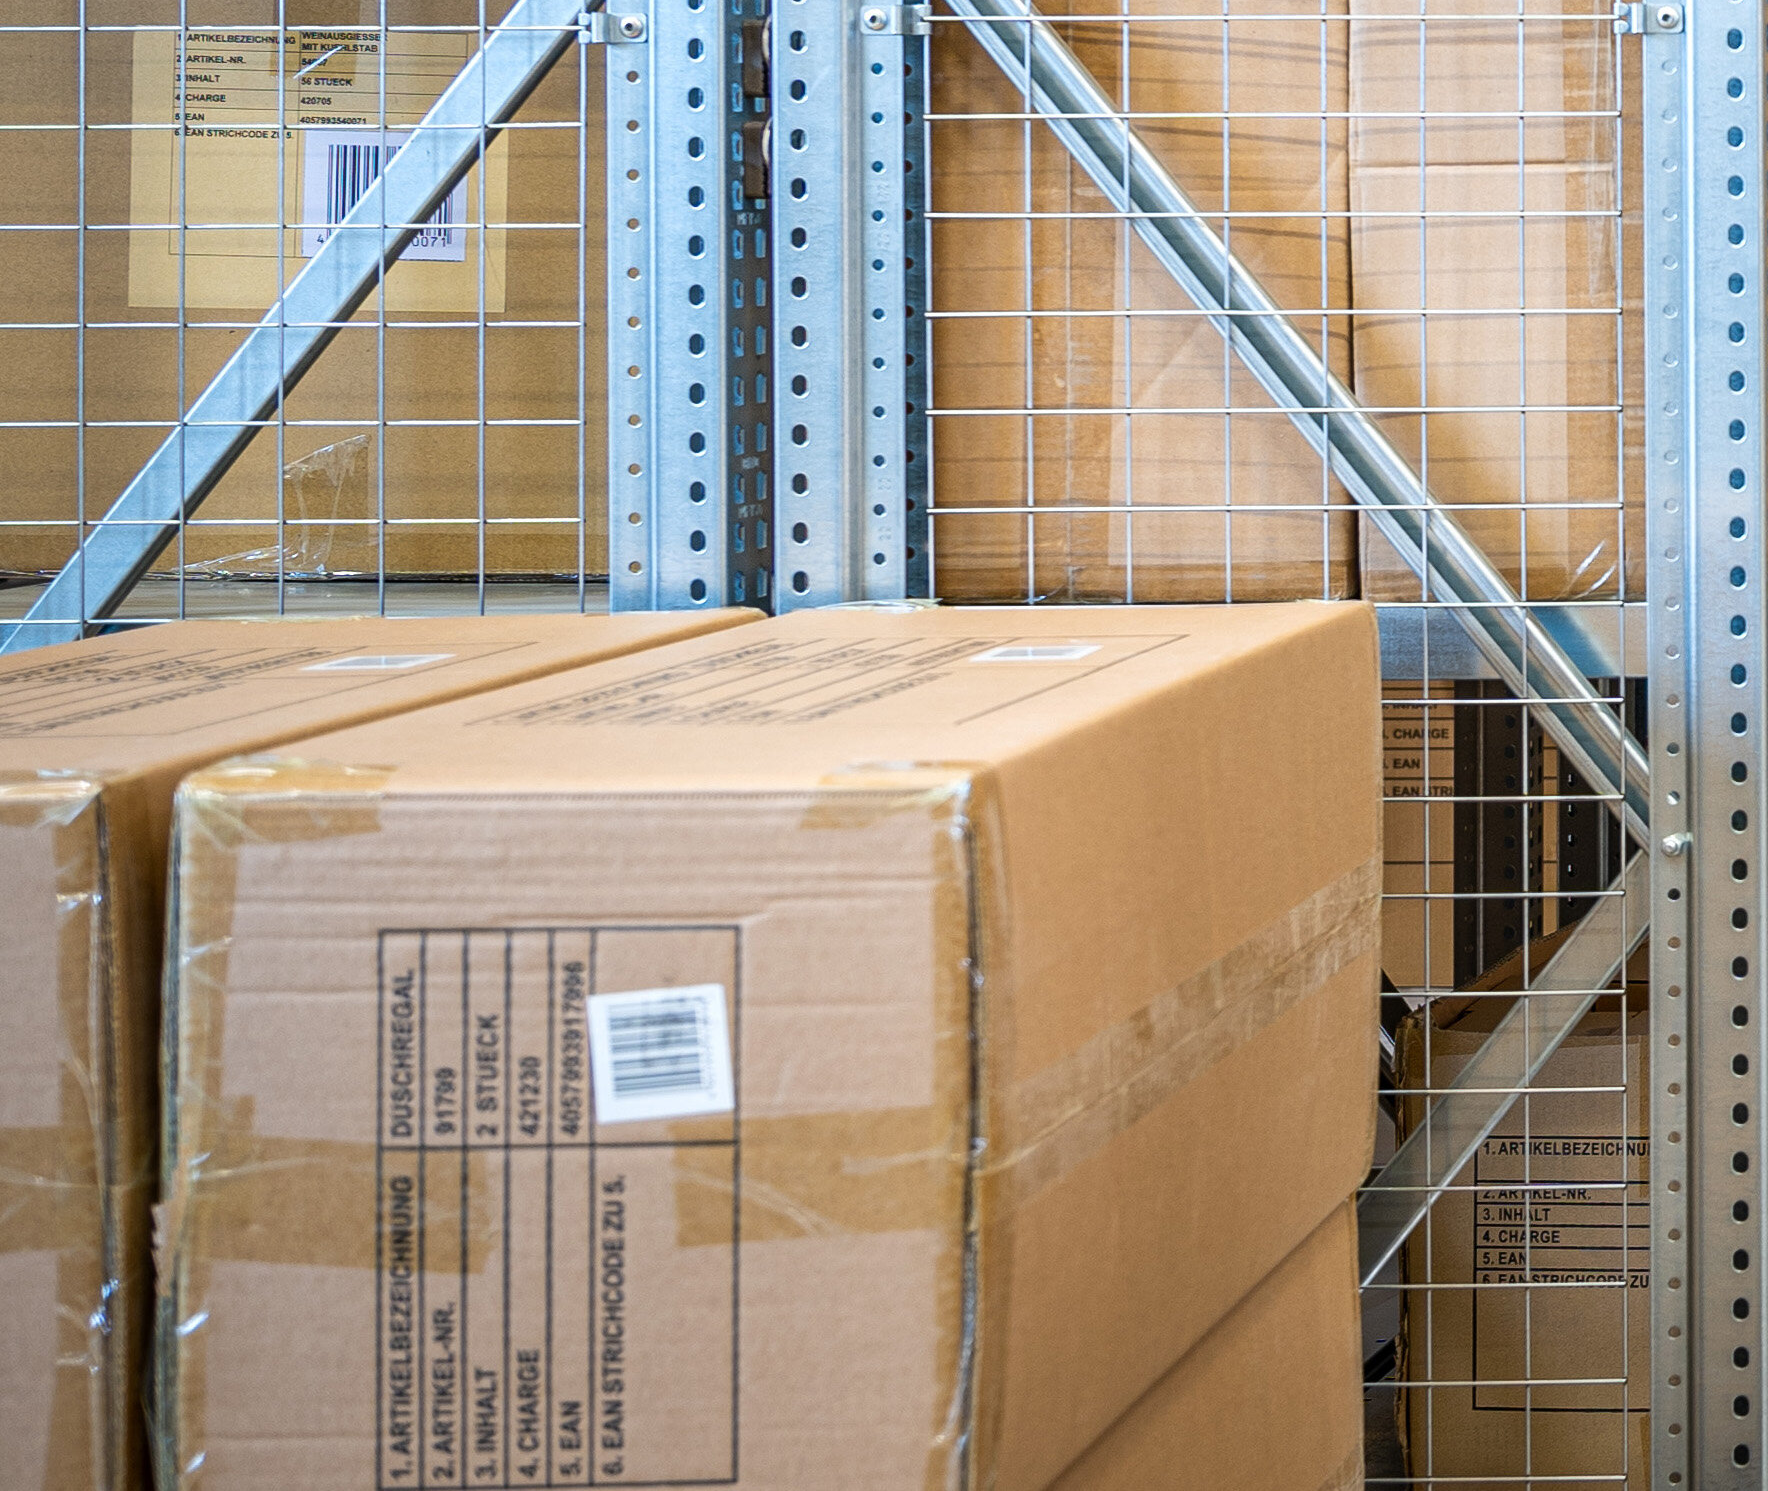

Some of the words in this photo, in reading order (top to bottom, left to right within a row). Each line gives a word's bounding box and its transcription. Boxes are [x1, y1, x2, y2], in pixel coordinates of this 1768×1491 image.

[301, 31, 388, 42] WEINAUSGIESSE
[301, 42, 317, 52] MIT
[314, 76, 353, 87] STUECK
[185, 93, 226, 103] CHARGE
[185, 112, 205, 122] EAN
[185, 129, 205, 139] EAN
[206, 129, 268, 140] STRICHCODE
[1393, 758, 1421, 769] EAN
[390, 968, 415, 1138] DUSCHREGAL
[475, 1014, 499, 1112] STUECK
[476, 1122, 498, 1137] 2
[603, 1200, 626, 1244] ZU
[1498, 1208, 1551, 1222] INHALT
[1498, 1230, 1560, 1244] CHARGE
[1498, 1252, 1527, 1266] EAN
[390, 1175, 416, 1456] ARTIKELBEZEICHNUNG
[603, 1250, 626, 1399] STRICHCODE
[433, 1302, 457, 1455] ARTIKEL-NR.
[516, 1348, 540, 1452] CHARGE
[475, 1367, 498, 1452] INHALT
[559, 1400, 582, 1450] EAN
[602, 1403, 625, 1450] EAN
